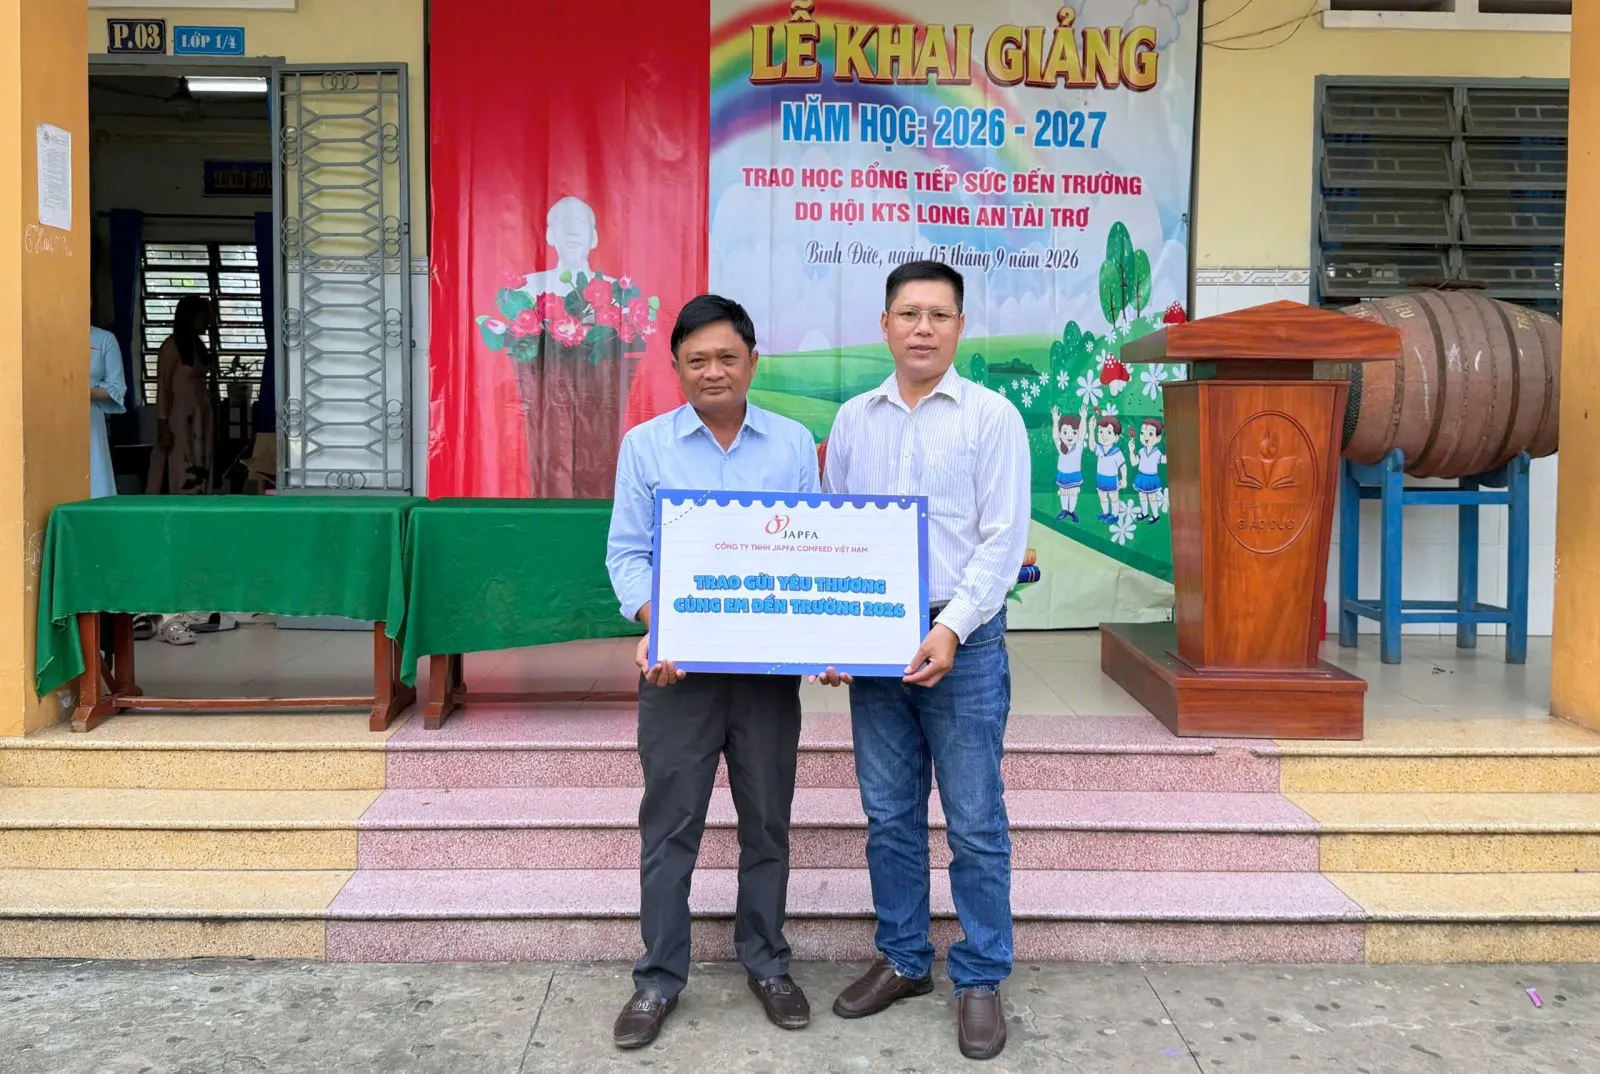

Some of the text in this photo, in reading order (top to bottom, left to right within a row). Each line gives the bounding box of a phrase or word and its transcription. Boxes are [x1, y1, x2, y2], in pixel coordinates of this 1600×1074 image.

[113, 23, 160, 49] P.03
[181, 31, 237, 50] LỚP 1/4
[749, 0, 1159, 92] LỄ KHAI GIẢNG
[782, 94, 851, 142] NĂM
[859, 103, 927, 152] HỌC:
[933, 107, 1005, 148] 2026
[1034, 108, 1107, 149] 2027
[742, 161, 1142, 196] TRAO HỌC BỔNG TIẾP SỨC ĐẾN TRƯỜNG
[795, 198, 1090, 232] DO HỘI KTS LONG AN TÀI TRỢ
[805, 240, 843, 265] Bình
[848, 240, 883, 269] Đức,
[951, 243, 991, 273] tháng
[995, 247, 1005, 271] 9
[1008, 249, 1040, 269] năm
[1044, 249, 1079, 270] 2026
[781, 530, 819, 540] JAPFA
[714, 542, 868, 555] CÔNG TY TNHH JAPFA COMFEED VIỆT NAM
[693, 572, 886, 594] TRAO GỬI YÊU THƯƠNG
[673, 594, 906, 618] CÙNG EM ĐẾN TRƯỜNG 2026
